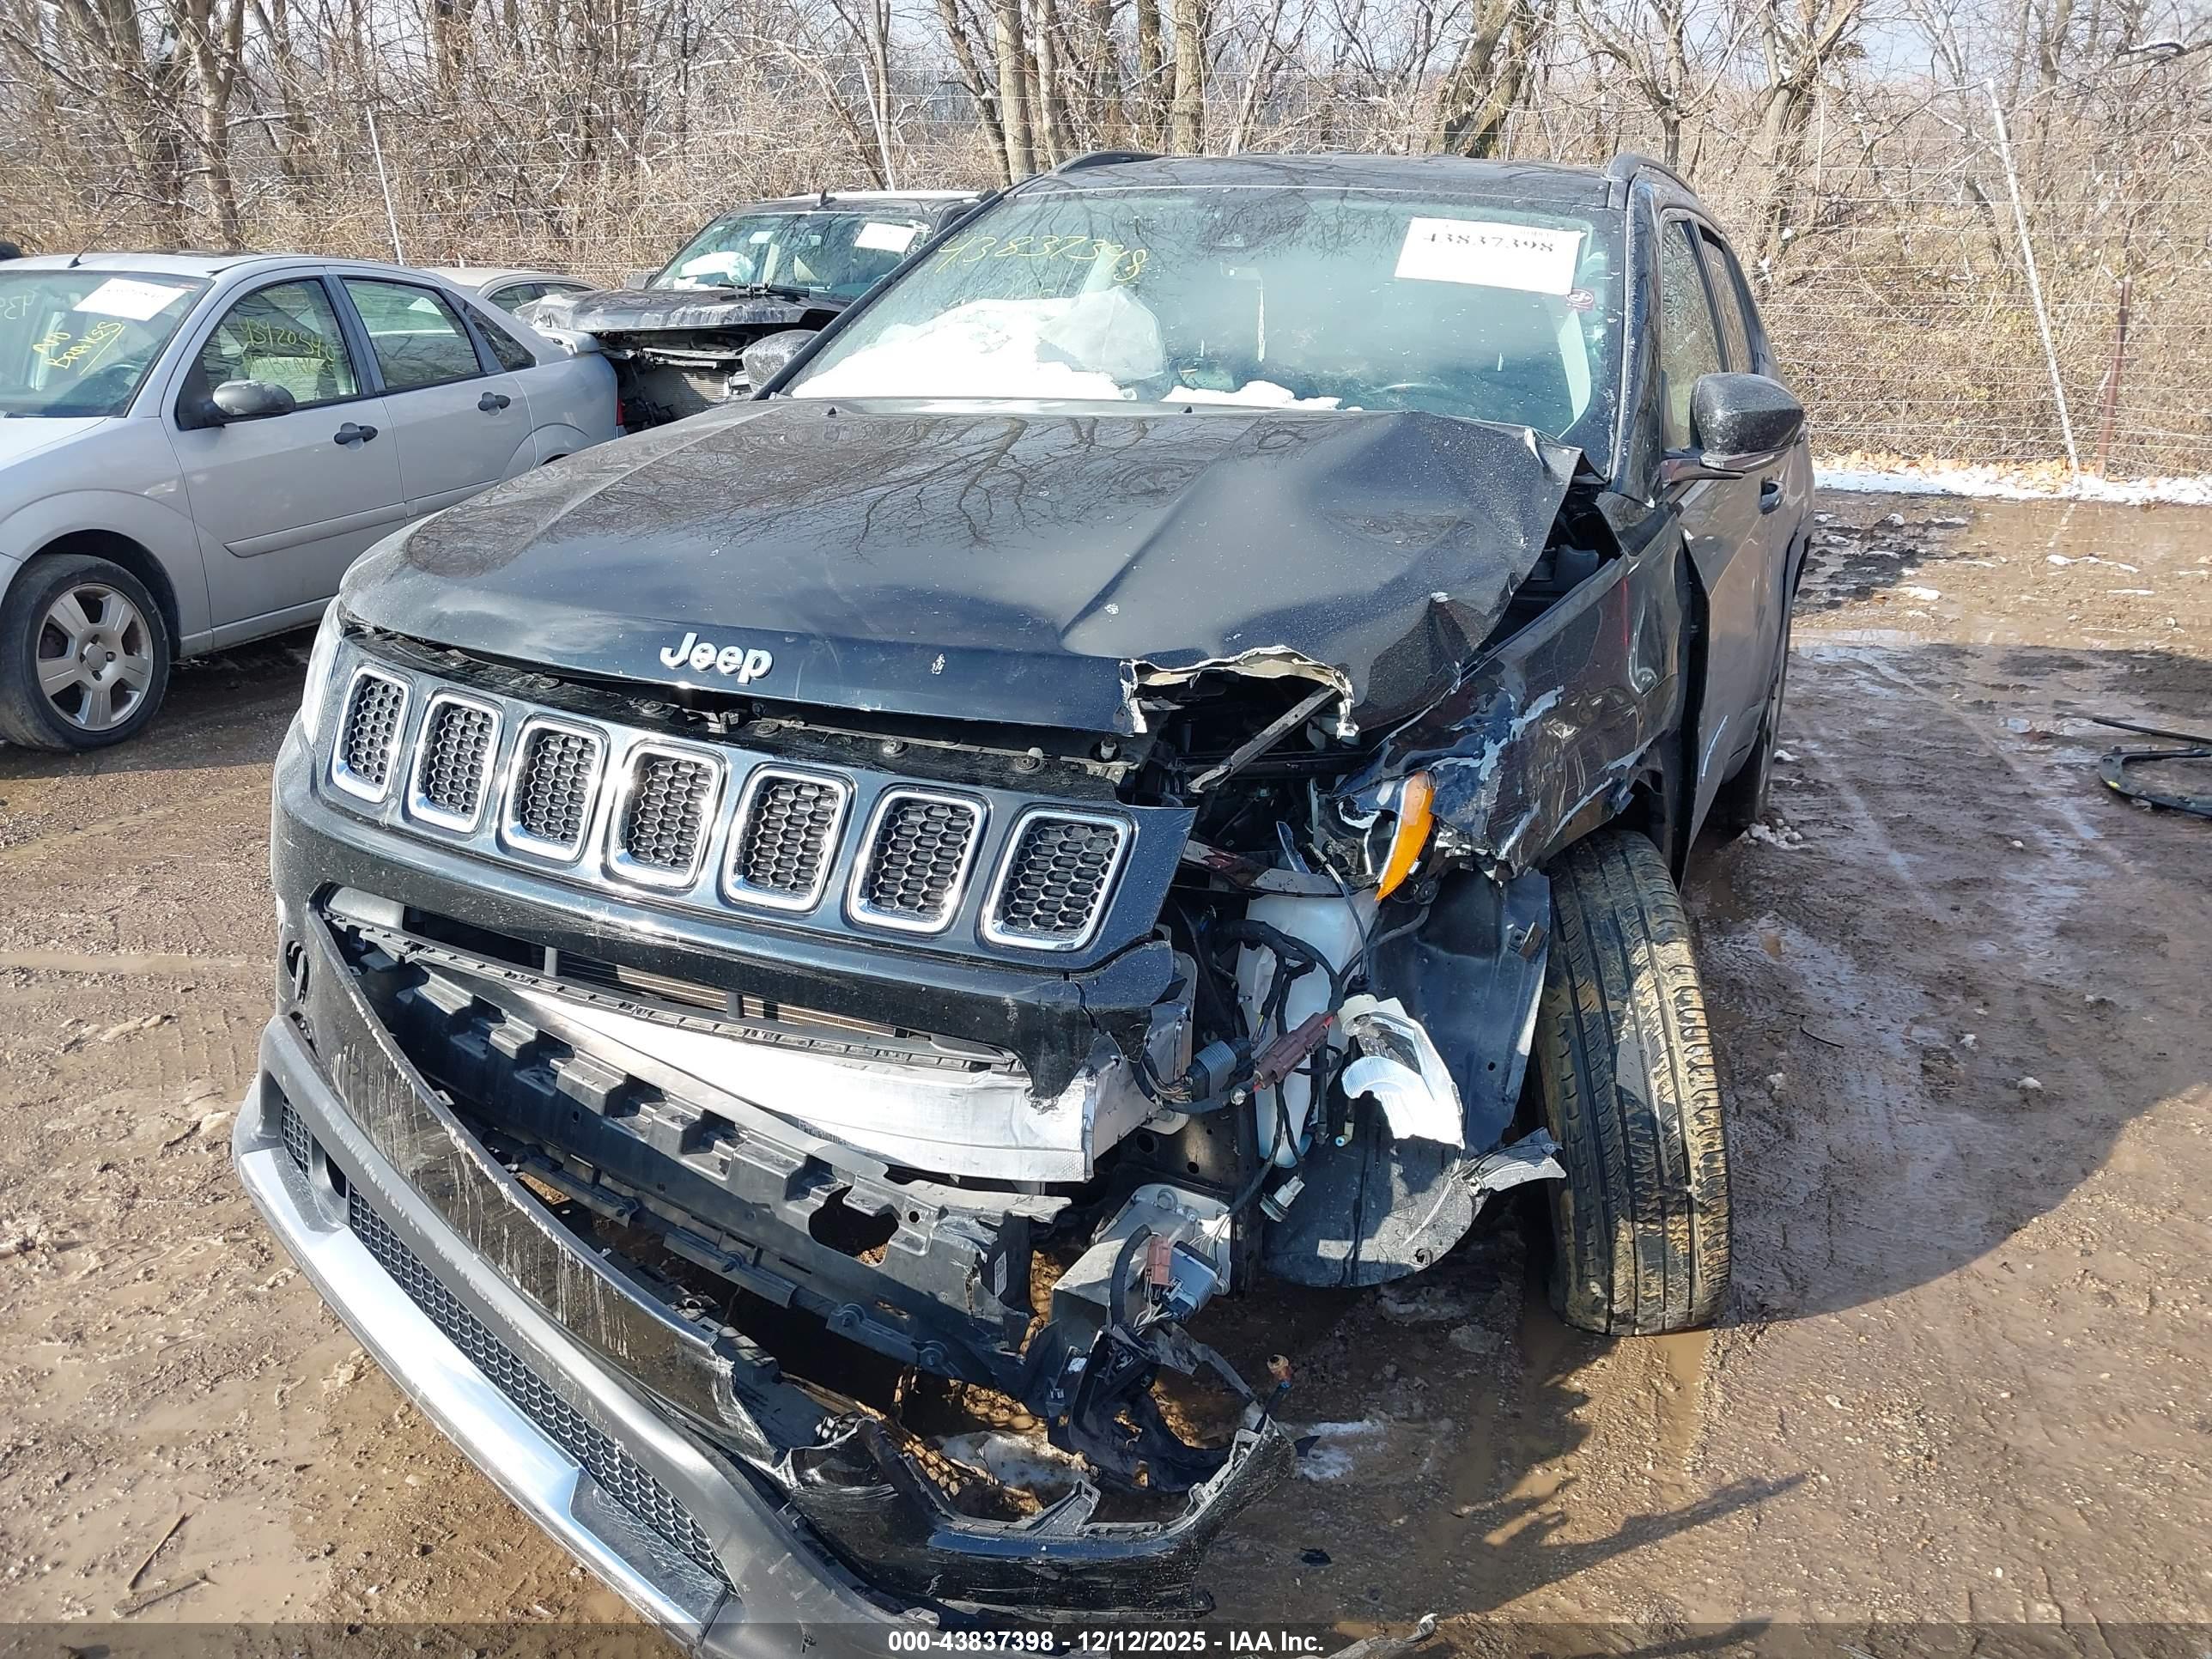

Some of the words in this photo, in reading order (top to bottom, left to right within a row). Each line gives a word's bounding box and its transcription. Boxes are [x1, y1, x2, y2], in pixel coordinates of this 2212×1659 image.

[935, 234, 1150, 282] 43837398
[1423, 233, 1553, 252] 43837398
[659, 632, 775, 686] Jeep
